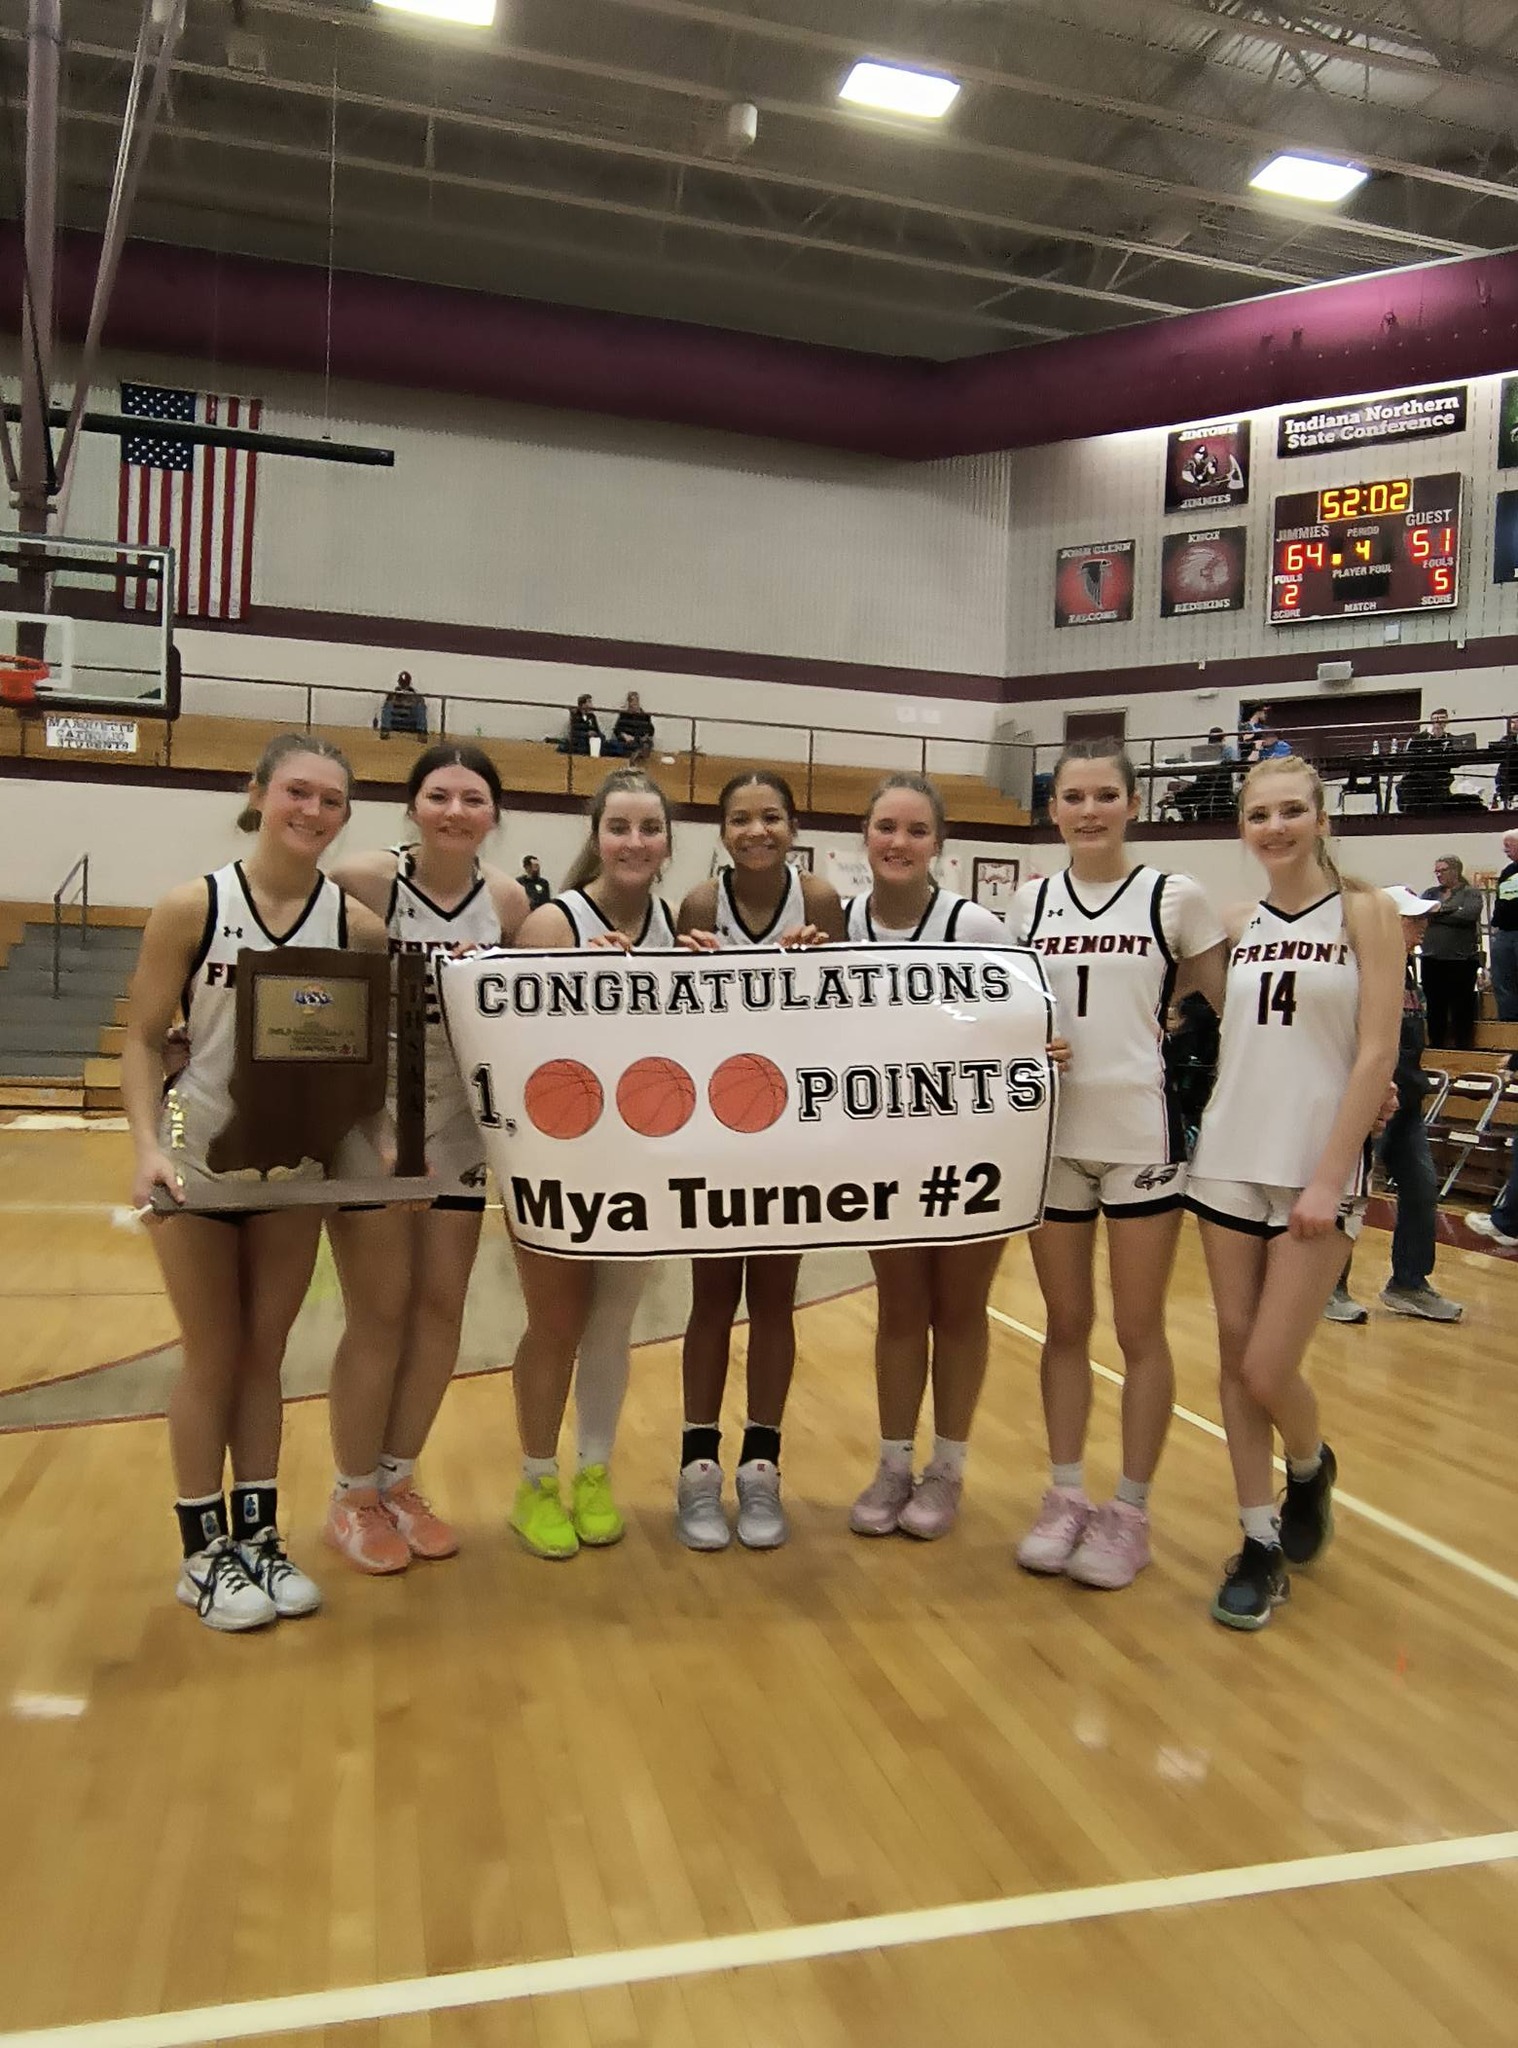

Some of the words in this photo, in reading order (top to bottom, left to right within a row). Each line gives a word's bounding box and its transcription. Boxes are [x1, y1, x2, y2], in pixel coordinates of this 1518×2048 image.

[1285, 412, 1361, 434] Indiana
[1365, 396, 1459, 421] Northern
[1287, 432, 1335, 449] State
[1340, 412, 1455, 440] Conference
[1323, 482, 1408, 519] 52:02
[1406, 509, 1452, 527] GUEST
[1276, 525, 1330, 542] JIMMIES
[1346, 526, 1379, 538] PERIOD
[1412, 528, 1451, 557] 51
[1287, 543, 1323, 570] 64
[1355, 540, 1371, 560] 4
[1274, 575, 1303, 585] FOULS
[1332, 564, 1367, 578] PLAYER
[1433, 568, 1449, 591] 5
[1284, 584, 1299, 605] 2
[1421, 594, 1452, 606] SCORE
[1272, 609, 1301, 620] SCORE
[1344, 602, 1377, 613] MATCH
[1032, 934, 1153, 957] FREMONT
[1232, 941, 1348, 967] FREMONT
[475, 962, 1012, 1018] CONGRATULATIONS
[1076, 965, 1090, 1017] 1
[1257, 970, 1297, 1026] 14
[796, 1058, 1047, 1121] POINTS
[511, 1175, 648, 1242] Mya
[669, 1176, 899, 1229] Turner
[919, 1162, 1001, 1218] #2
